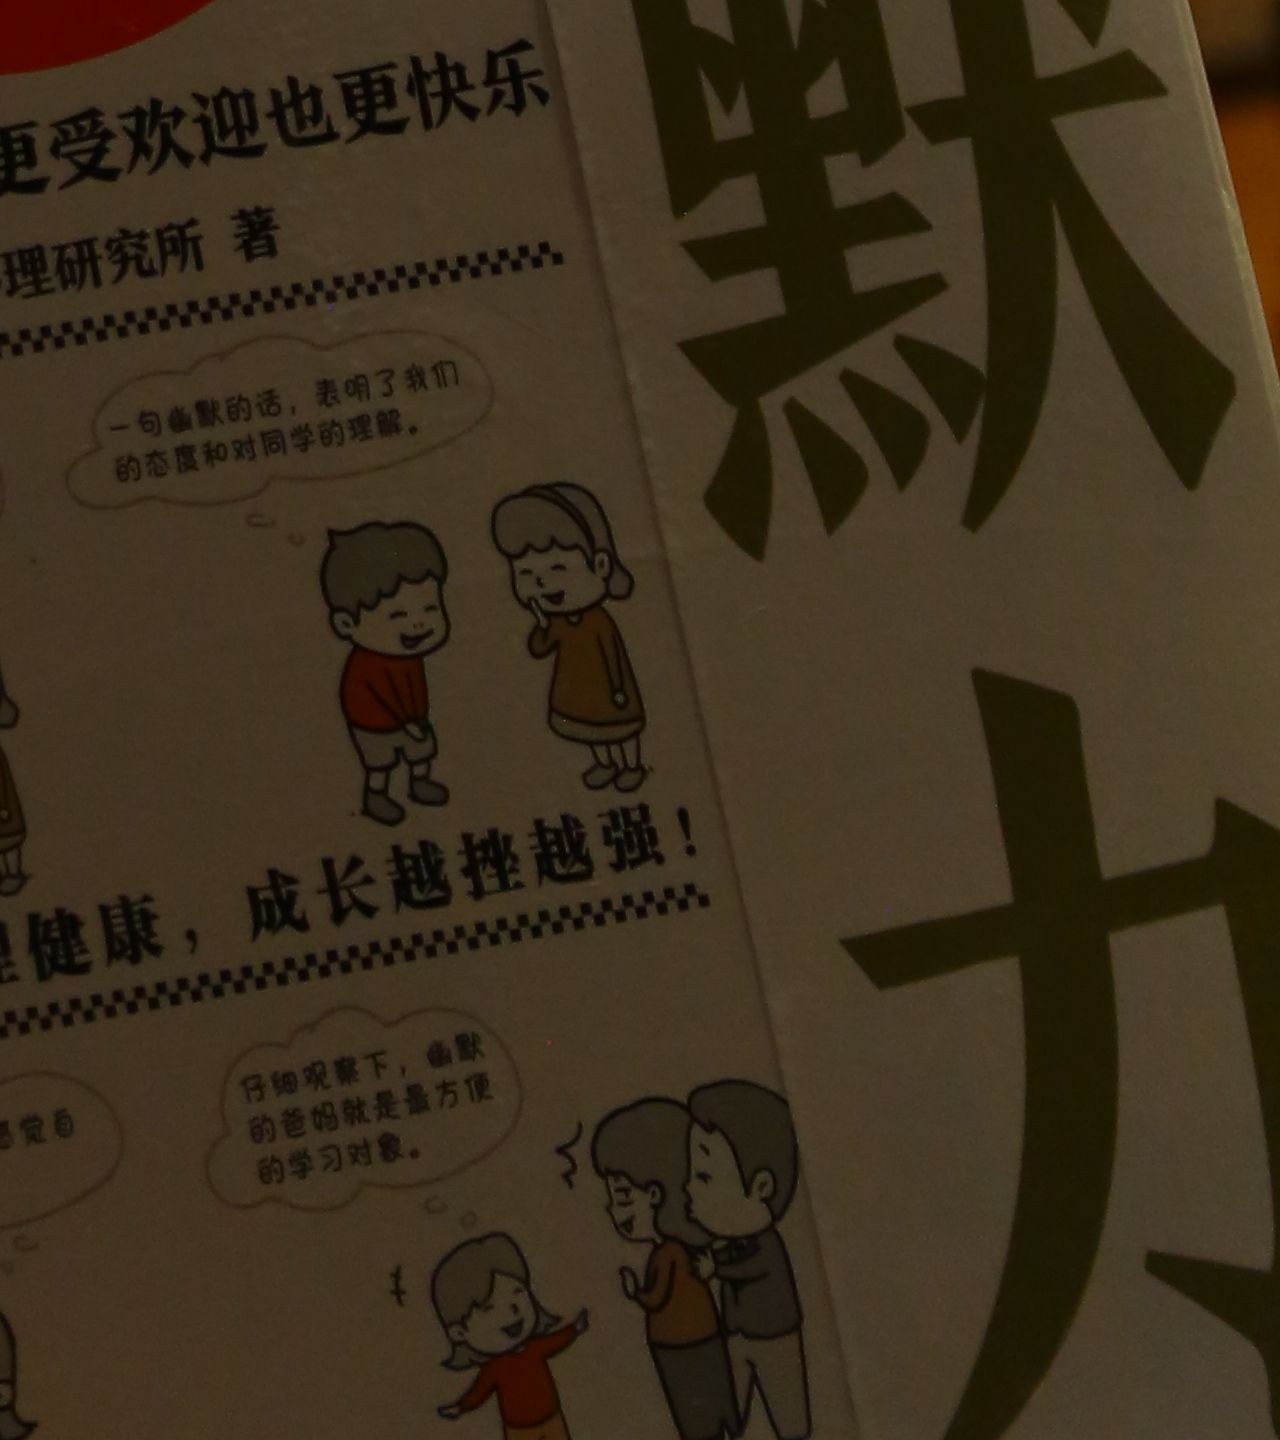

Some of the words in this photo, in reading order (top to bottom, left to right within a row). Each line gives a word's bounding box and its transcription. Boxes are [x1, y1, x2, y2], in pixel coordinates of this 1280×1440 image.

[231, 204, 281, 265] 著
[109, 360, 461, 438] 一句幽默的话，表明了我们
[115, 408, 419, 483] 的态度和对同学的理解。
[240, 1030, 487, 1106] 仔细观察下，幽默
[247, 1073, 495, 1146] 的爸妈就是最方便
[257, 1139, 424, 1187] 的学习对象。
